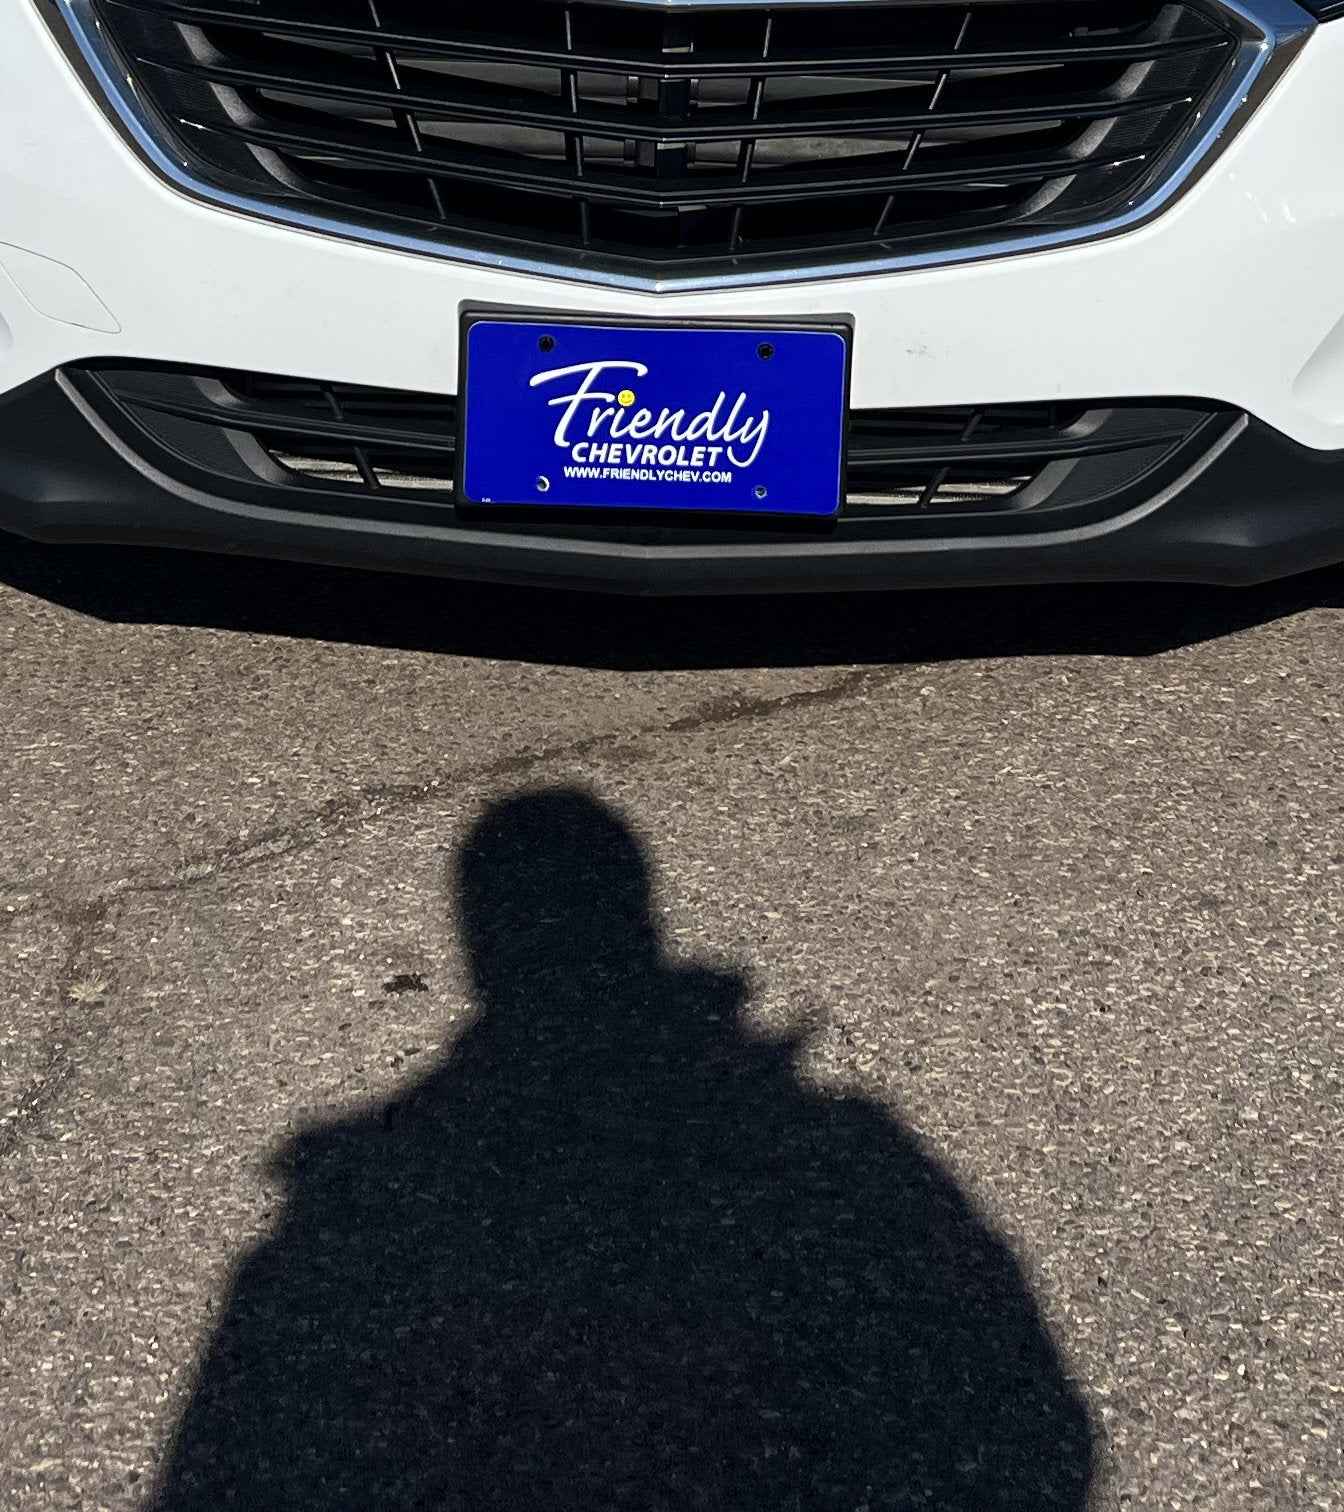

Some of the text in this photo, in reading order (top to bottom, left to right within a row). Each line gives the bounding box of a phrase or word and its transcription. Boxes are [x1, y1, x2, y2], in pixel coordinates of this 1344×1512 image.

[529, 360, 769, 468] Friendly
[571, 442, 723, 467] CHEVROLET
[563, 466, 732, 483] WWW.FRIENDLYCHEV.COM
